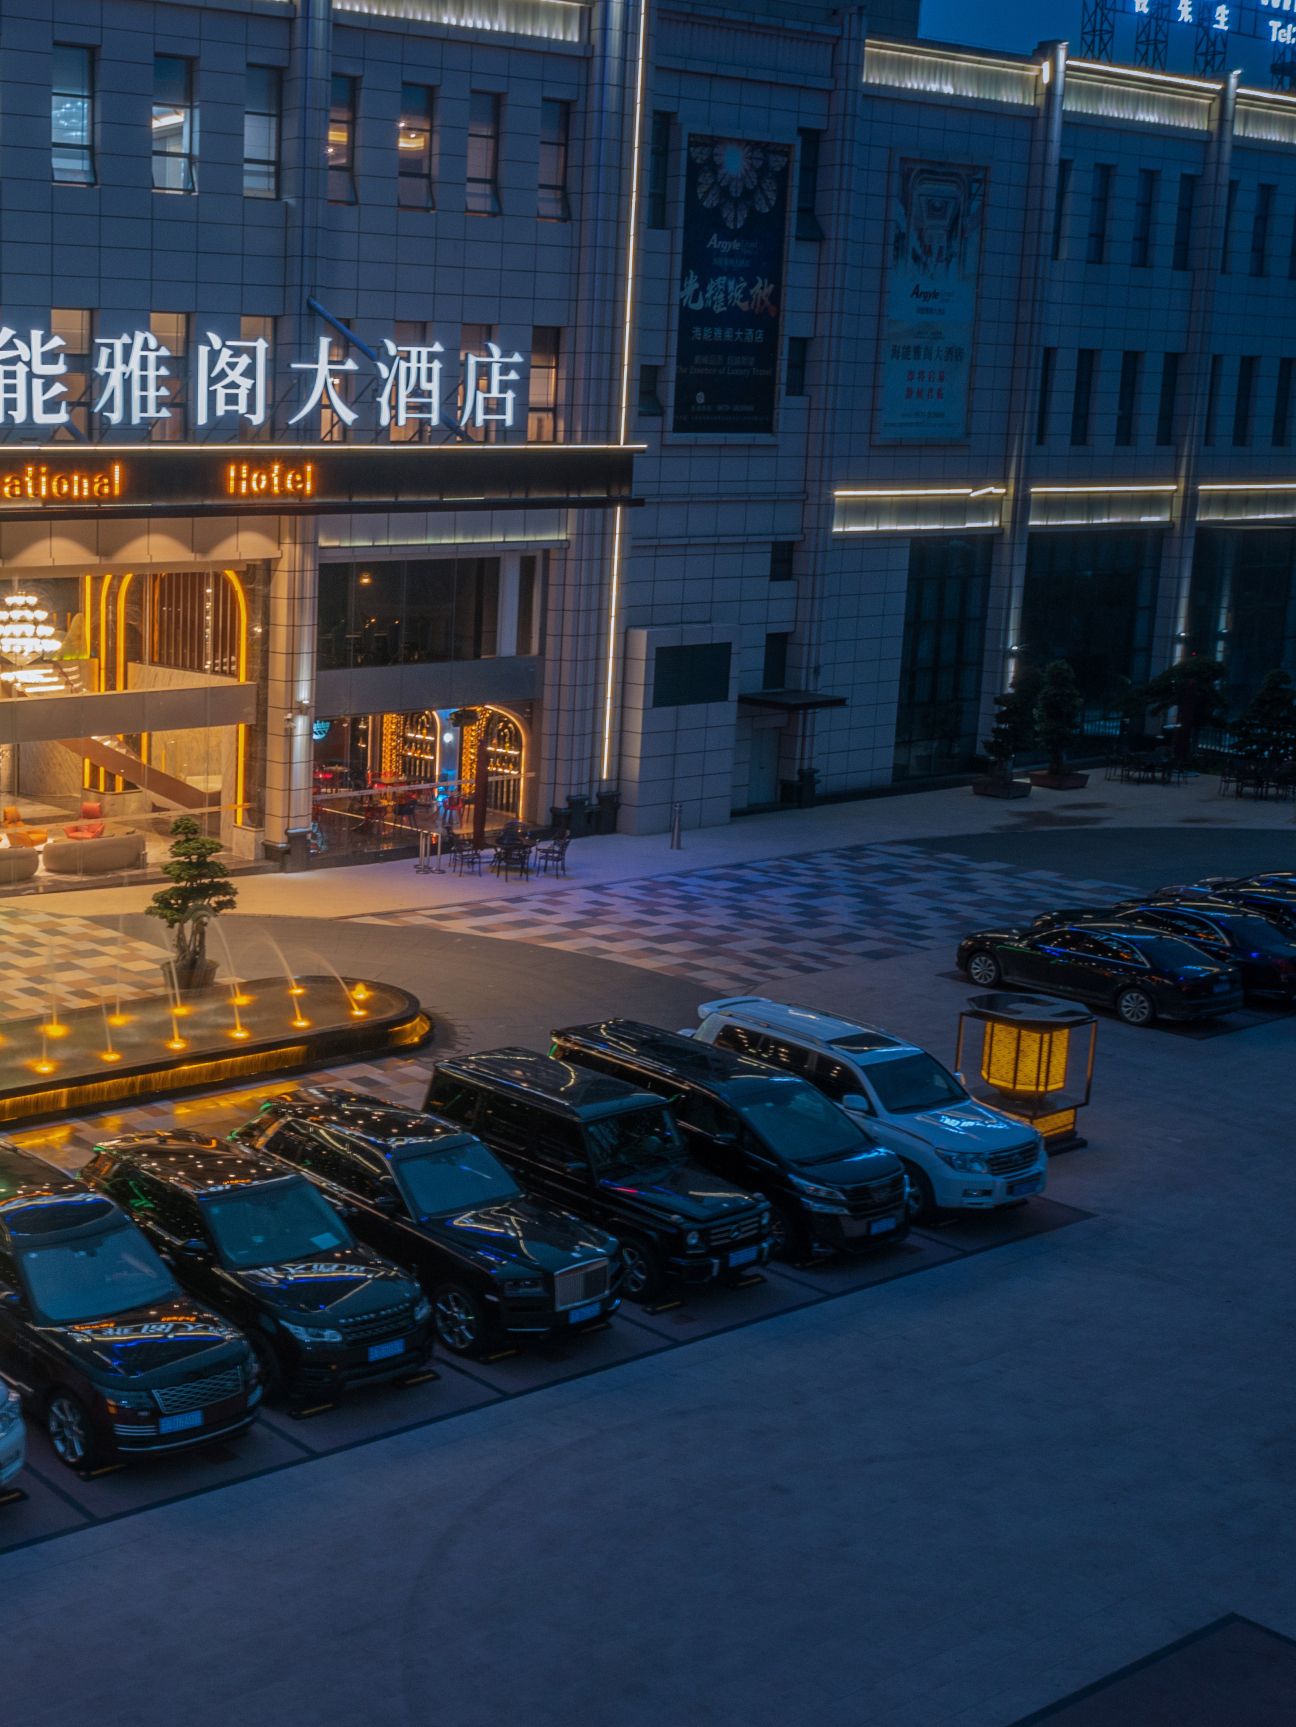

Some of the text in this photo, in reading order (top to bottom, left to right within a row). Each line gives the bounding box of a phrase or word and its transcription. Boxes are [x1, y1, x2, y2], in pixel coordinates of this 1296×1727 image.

[706, 233, 741, 253] Argyle
[910, 283, 939, 303] Argyle
[692, 326, 764, 343] 海能雅阁大酒店
[890, 344, 964, 362] 海能雅阁大酒店
[727, 367, 750, 378] Luxury
[227, 462, 314, 496] Hotel
